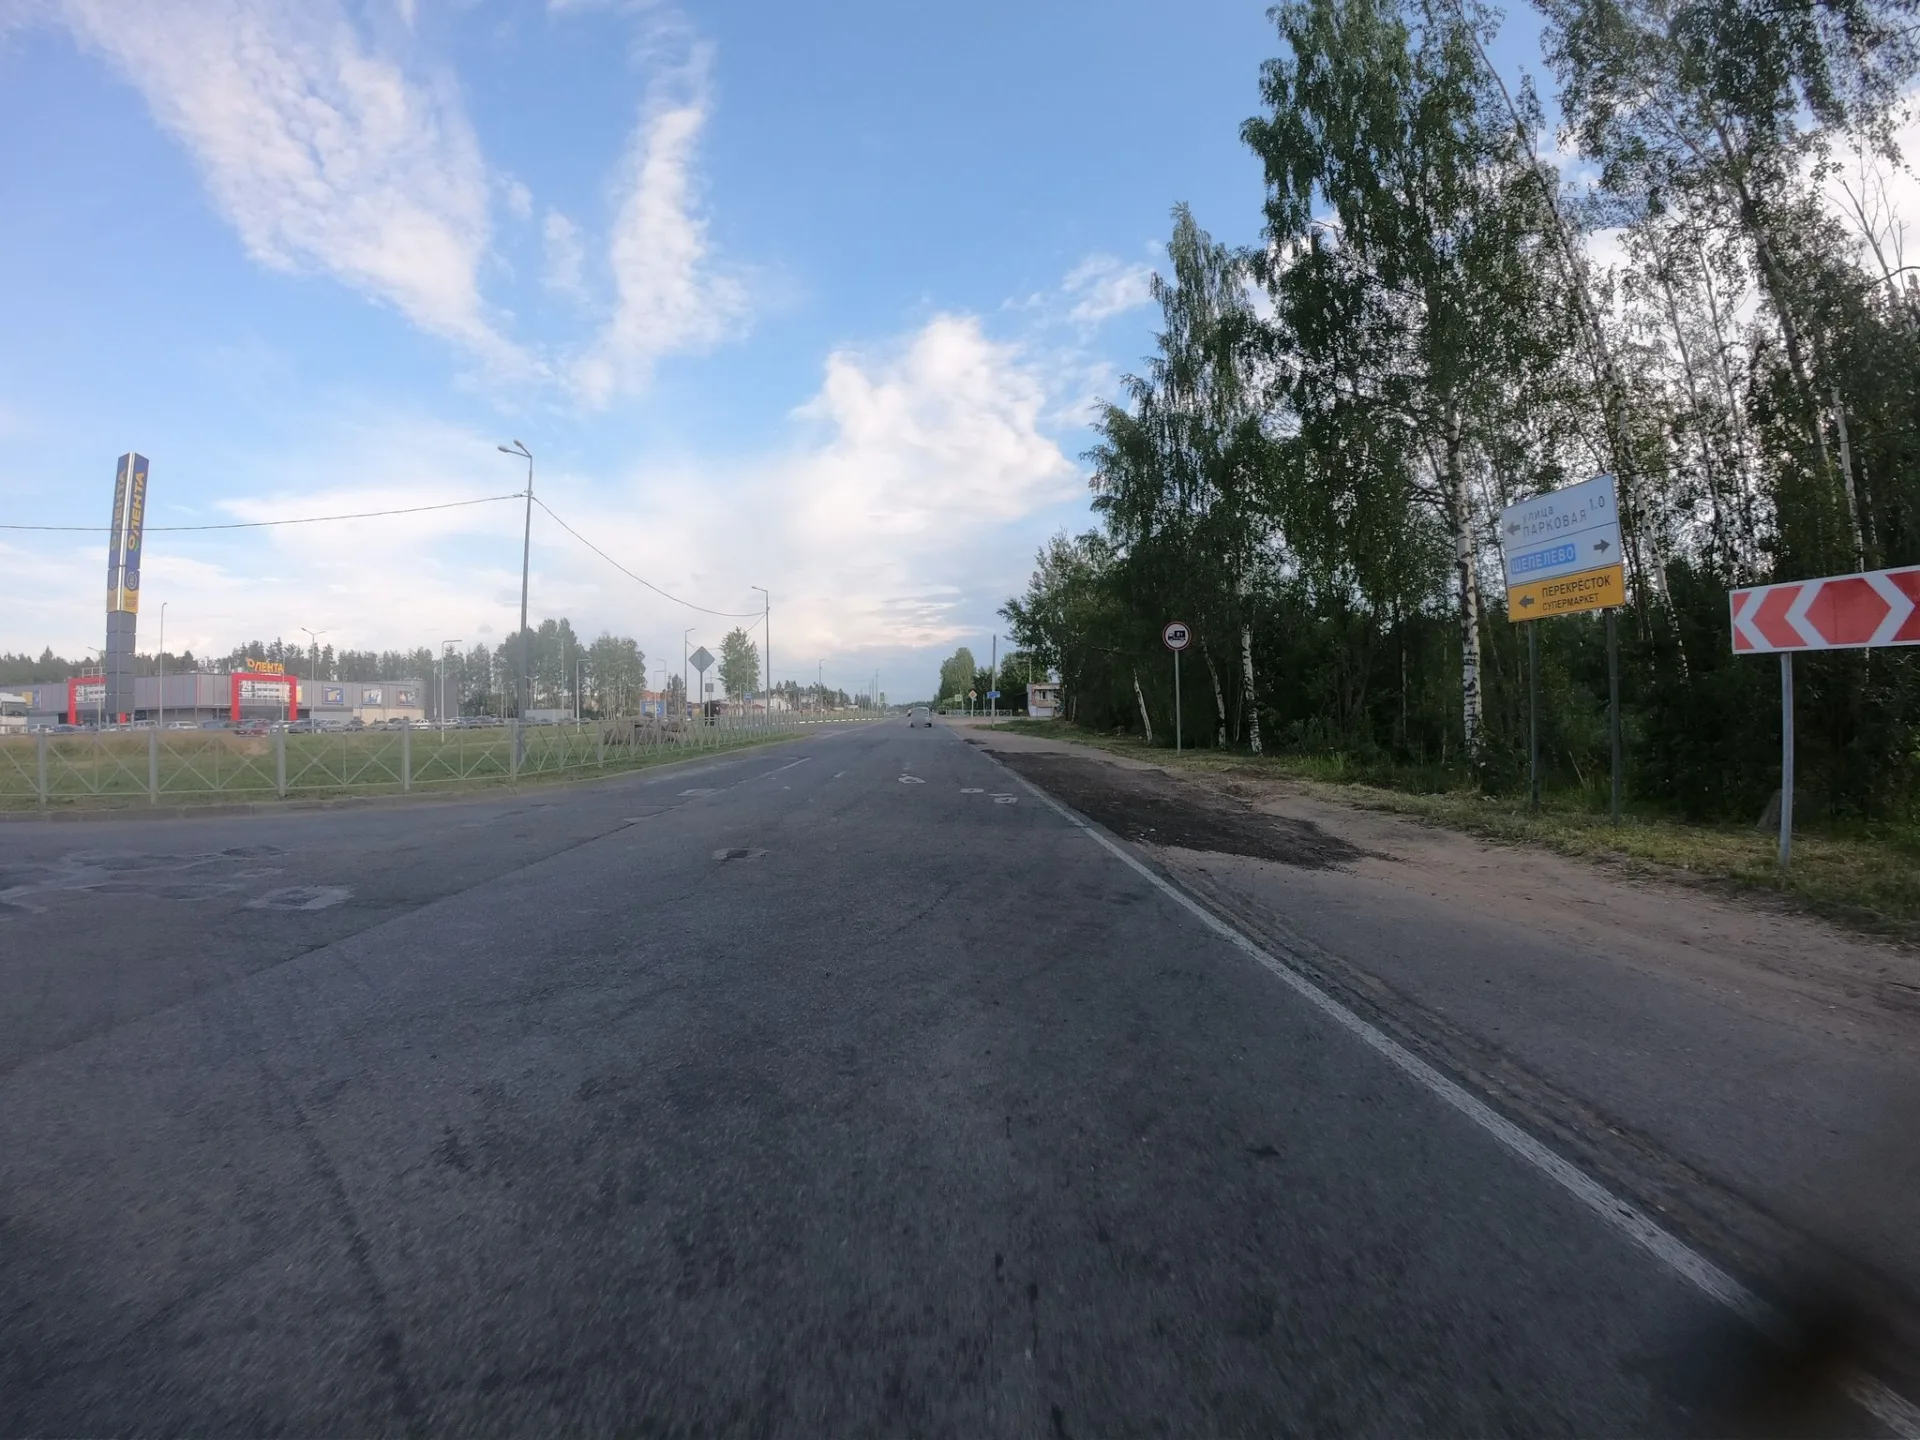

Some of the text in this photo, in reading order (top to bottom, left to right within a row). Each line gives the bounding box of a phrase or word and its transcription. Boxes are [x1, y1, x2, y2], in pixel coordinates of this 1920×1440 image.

[131, 472, 145, 536] ЛЕНТА
[1589, 495, 1604, 511] 1.0
[1522, 506, 1554, 523] улица
[1523, 509, 1586, 537] ПАРКОВАЯ
[1512, 546, 1574, 572] ШЕПЕЛЕВО
[1543, 592, 1599, 611] СУПЕРМАРКЕТ
[254, 661, 284, 672] ЛЕНТА
